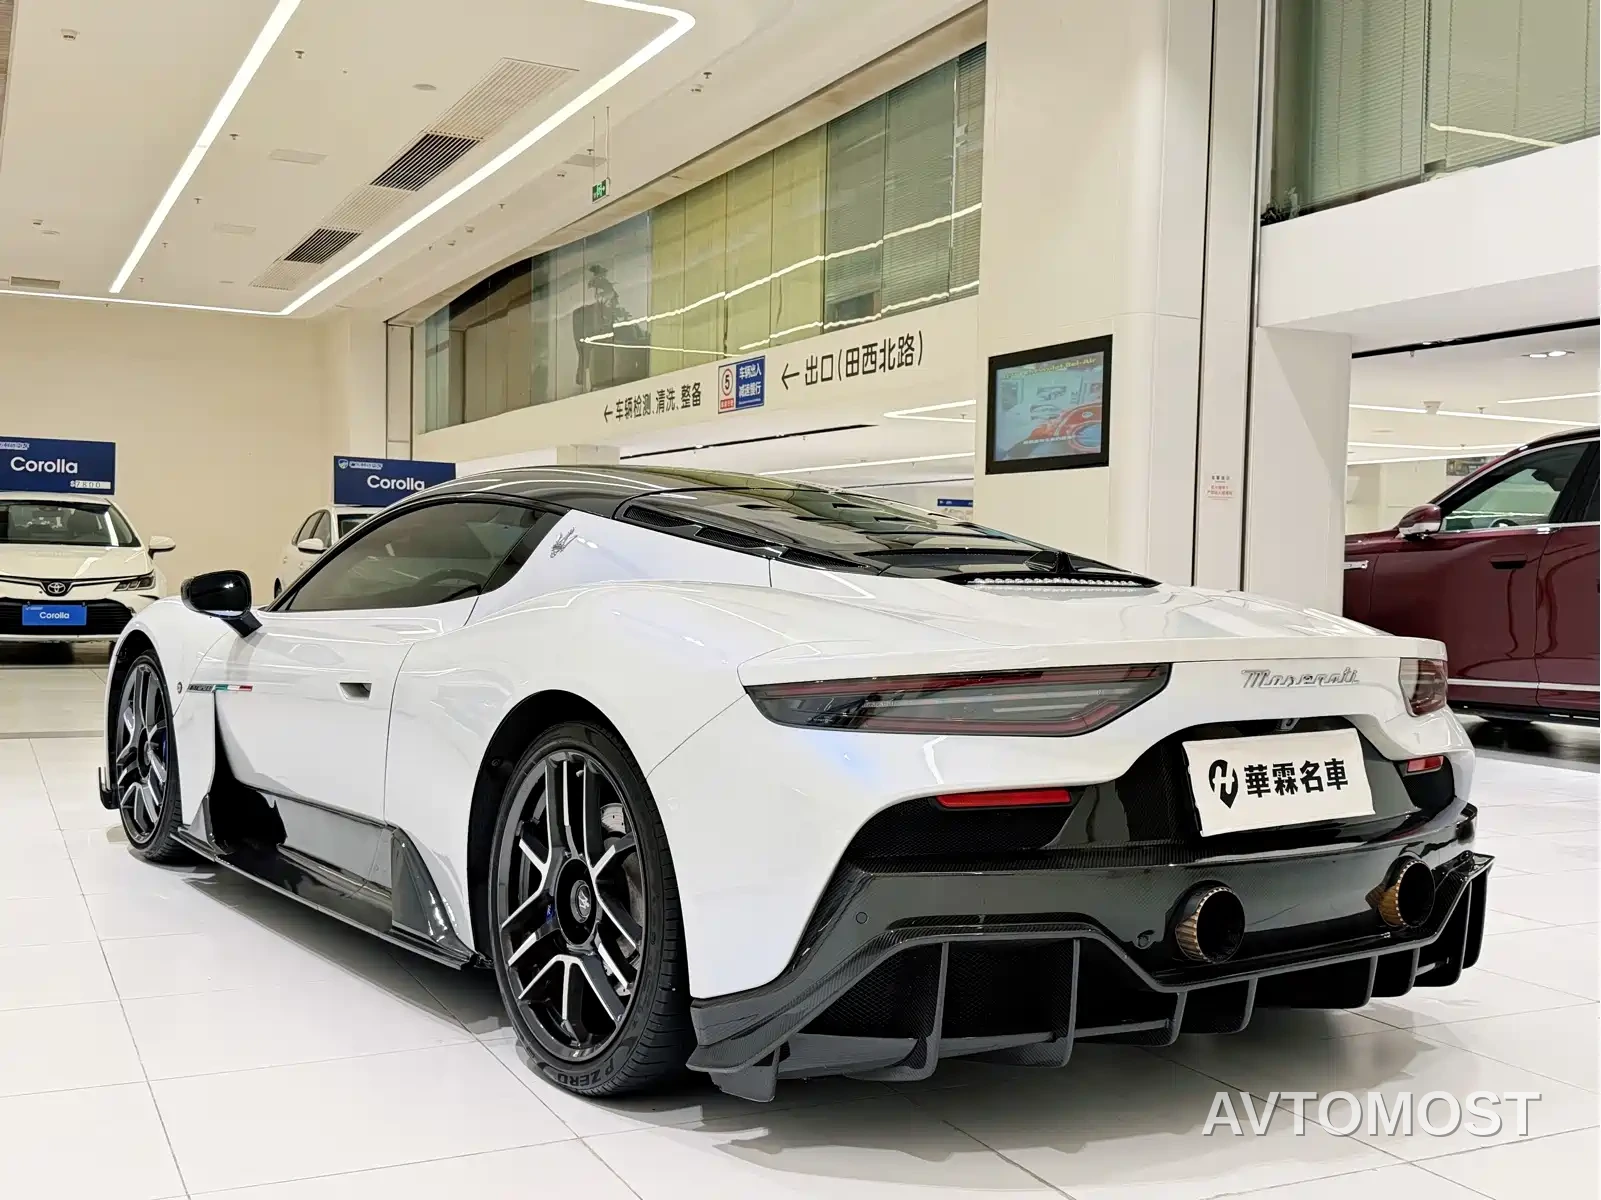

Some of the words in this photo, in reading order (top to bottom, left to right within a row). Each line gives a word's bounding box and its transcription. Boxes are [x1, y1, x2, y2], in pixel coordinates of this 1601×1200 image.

[804, 330, 923, 386] 出口(田西北路)
[724, 374, 730, 390] 5
[10, 456, 79, 474] Corolla
[366, 475, 426, 491] Corolla
[39, 611, 70, 619] Corolla
[1240, 666, 1360, 689] Maserati
[1243, 758, 1349, 798] 華霖名車
[604, 1058, 614, 1076] P
[557, 1069, 602, 1087] ZERO
